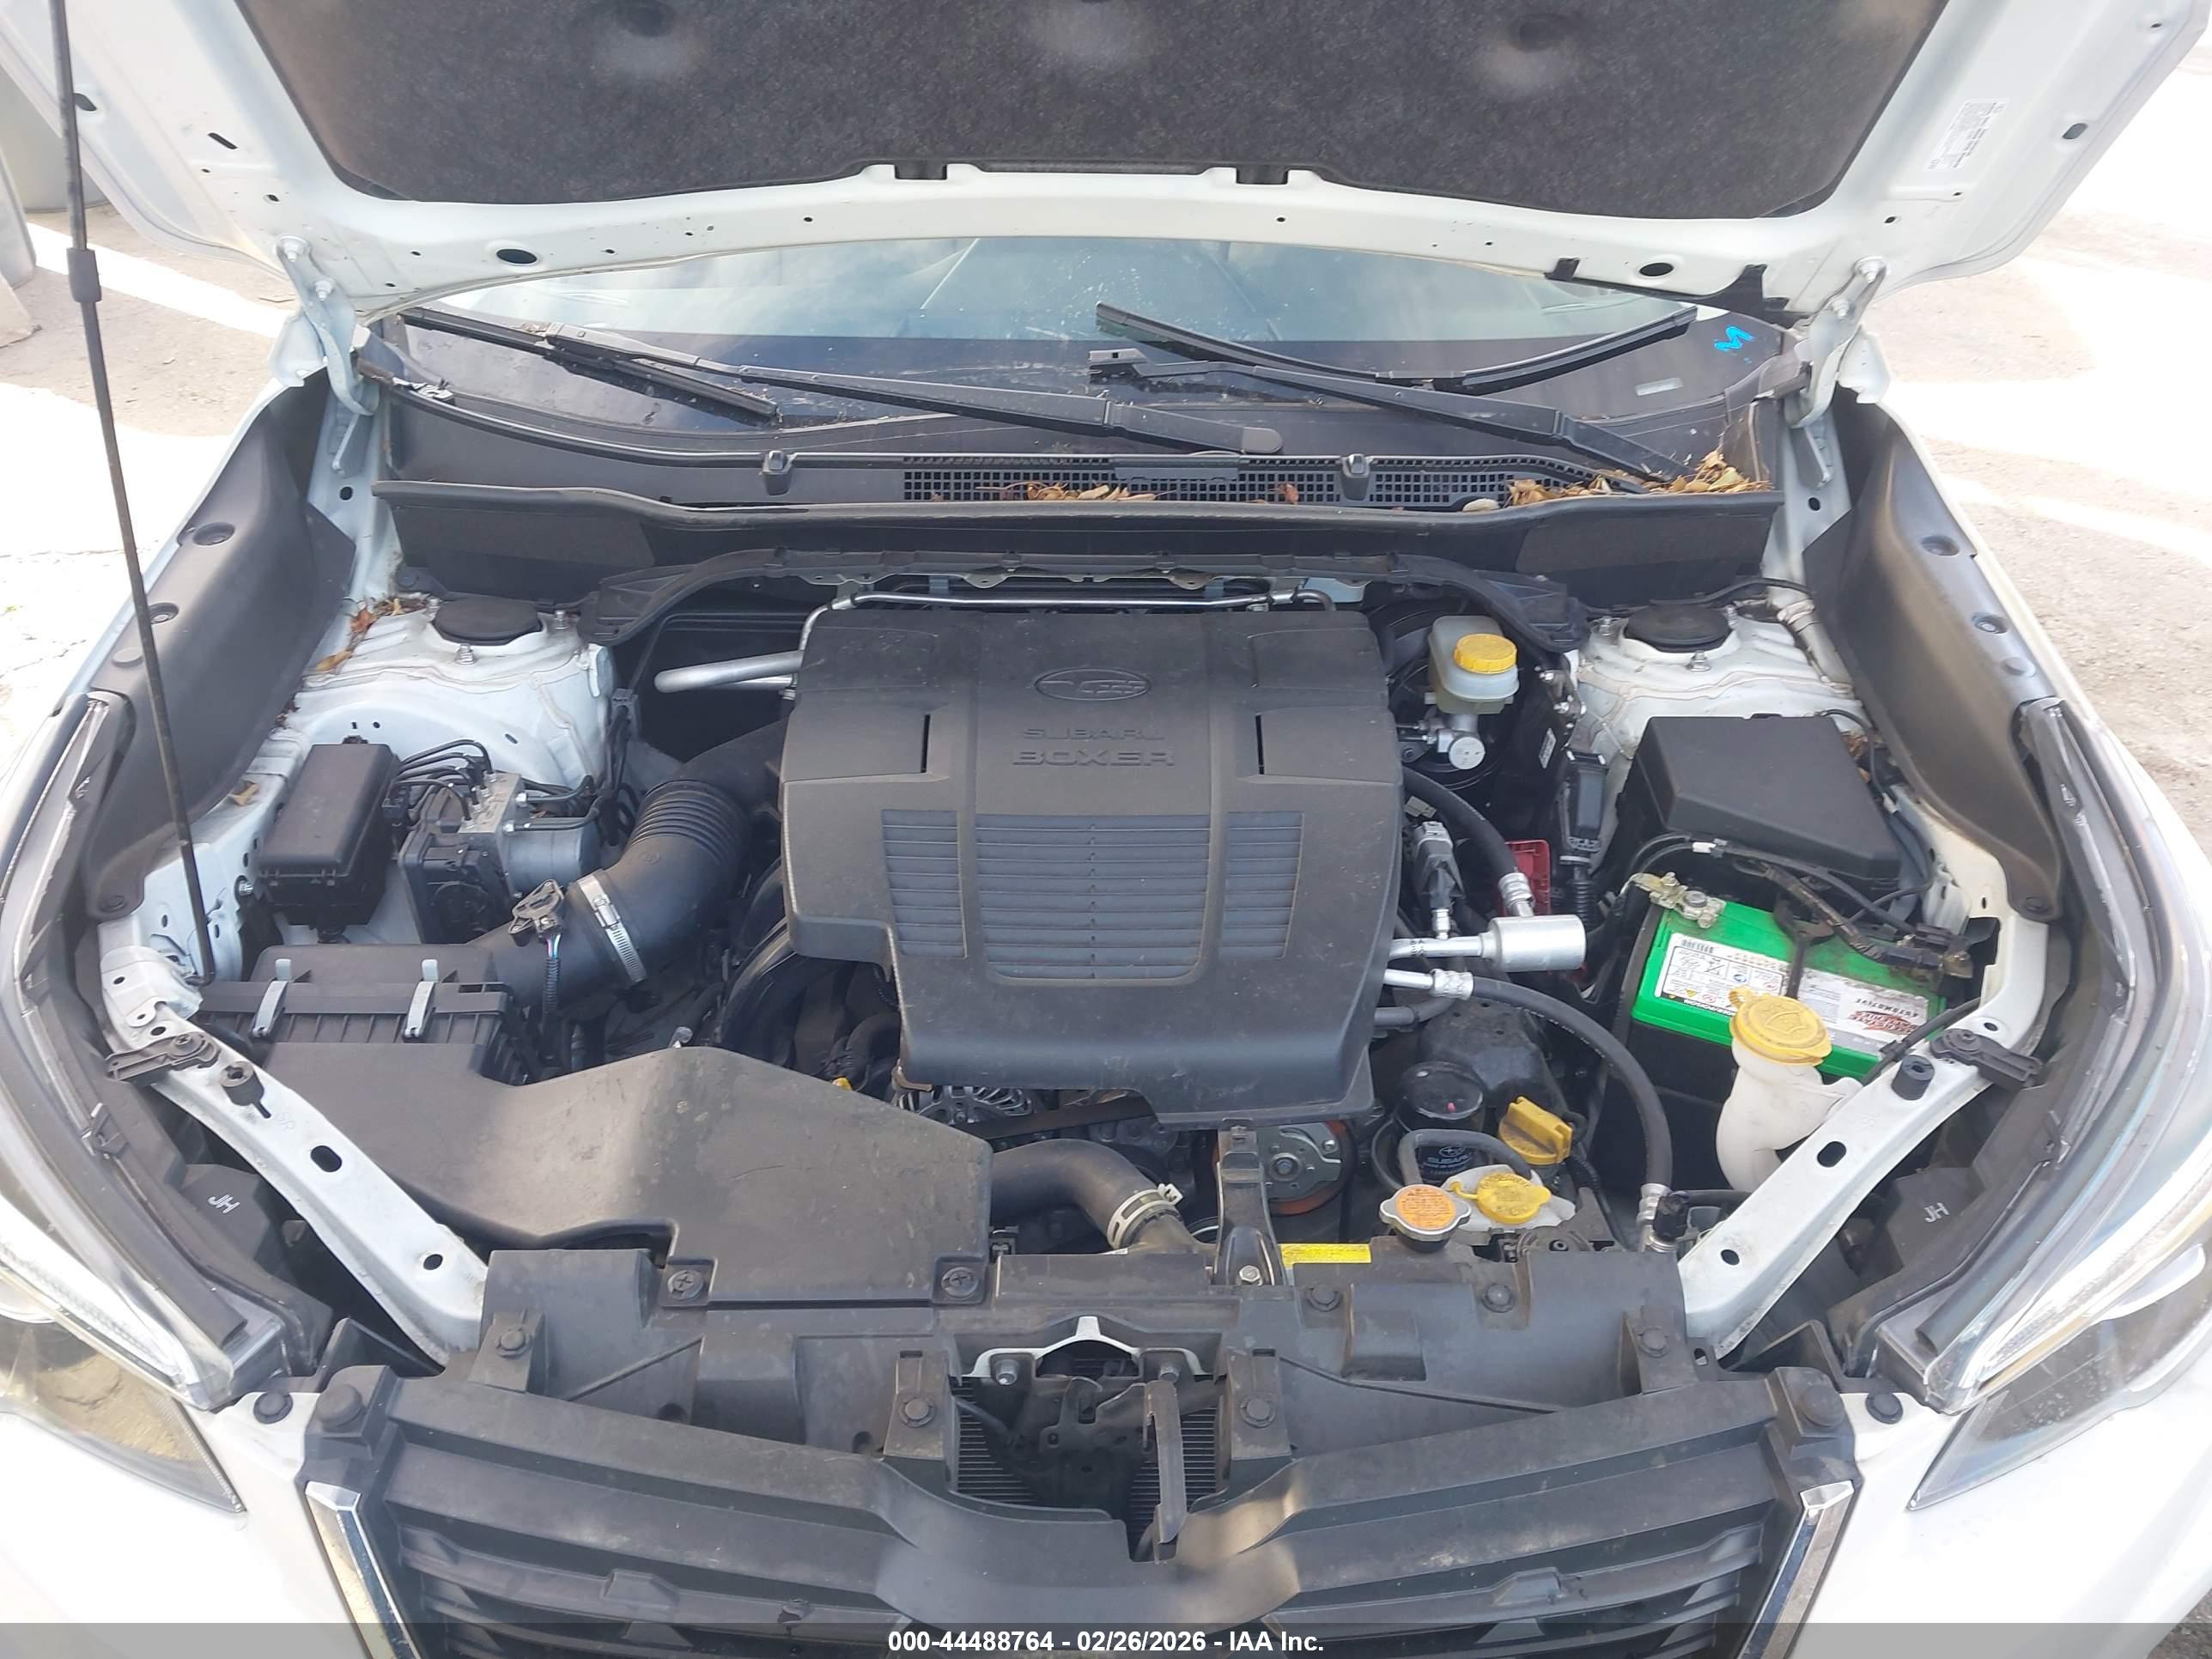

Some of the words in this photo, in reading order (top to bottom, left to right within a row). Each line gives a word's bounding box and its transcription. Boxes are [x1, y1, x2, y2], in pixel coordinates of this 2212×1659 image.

[1012, 749, 1176, 766] BOXER
[1855, 998, 1919, 1018] AUTOMOTIVE
[207, 1194, 240, 1214] JH
[1923, 1202, 1950, 1223] JH
